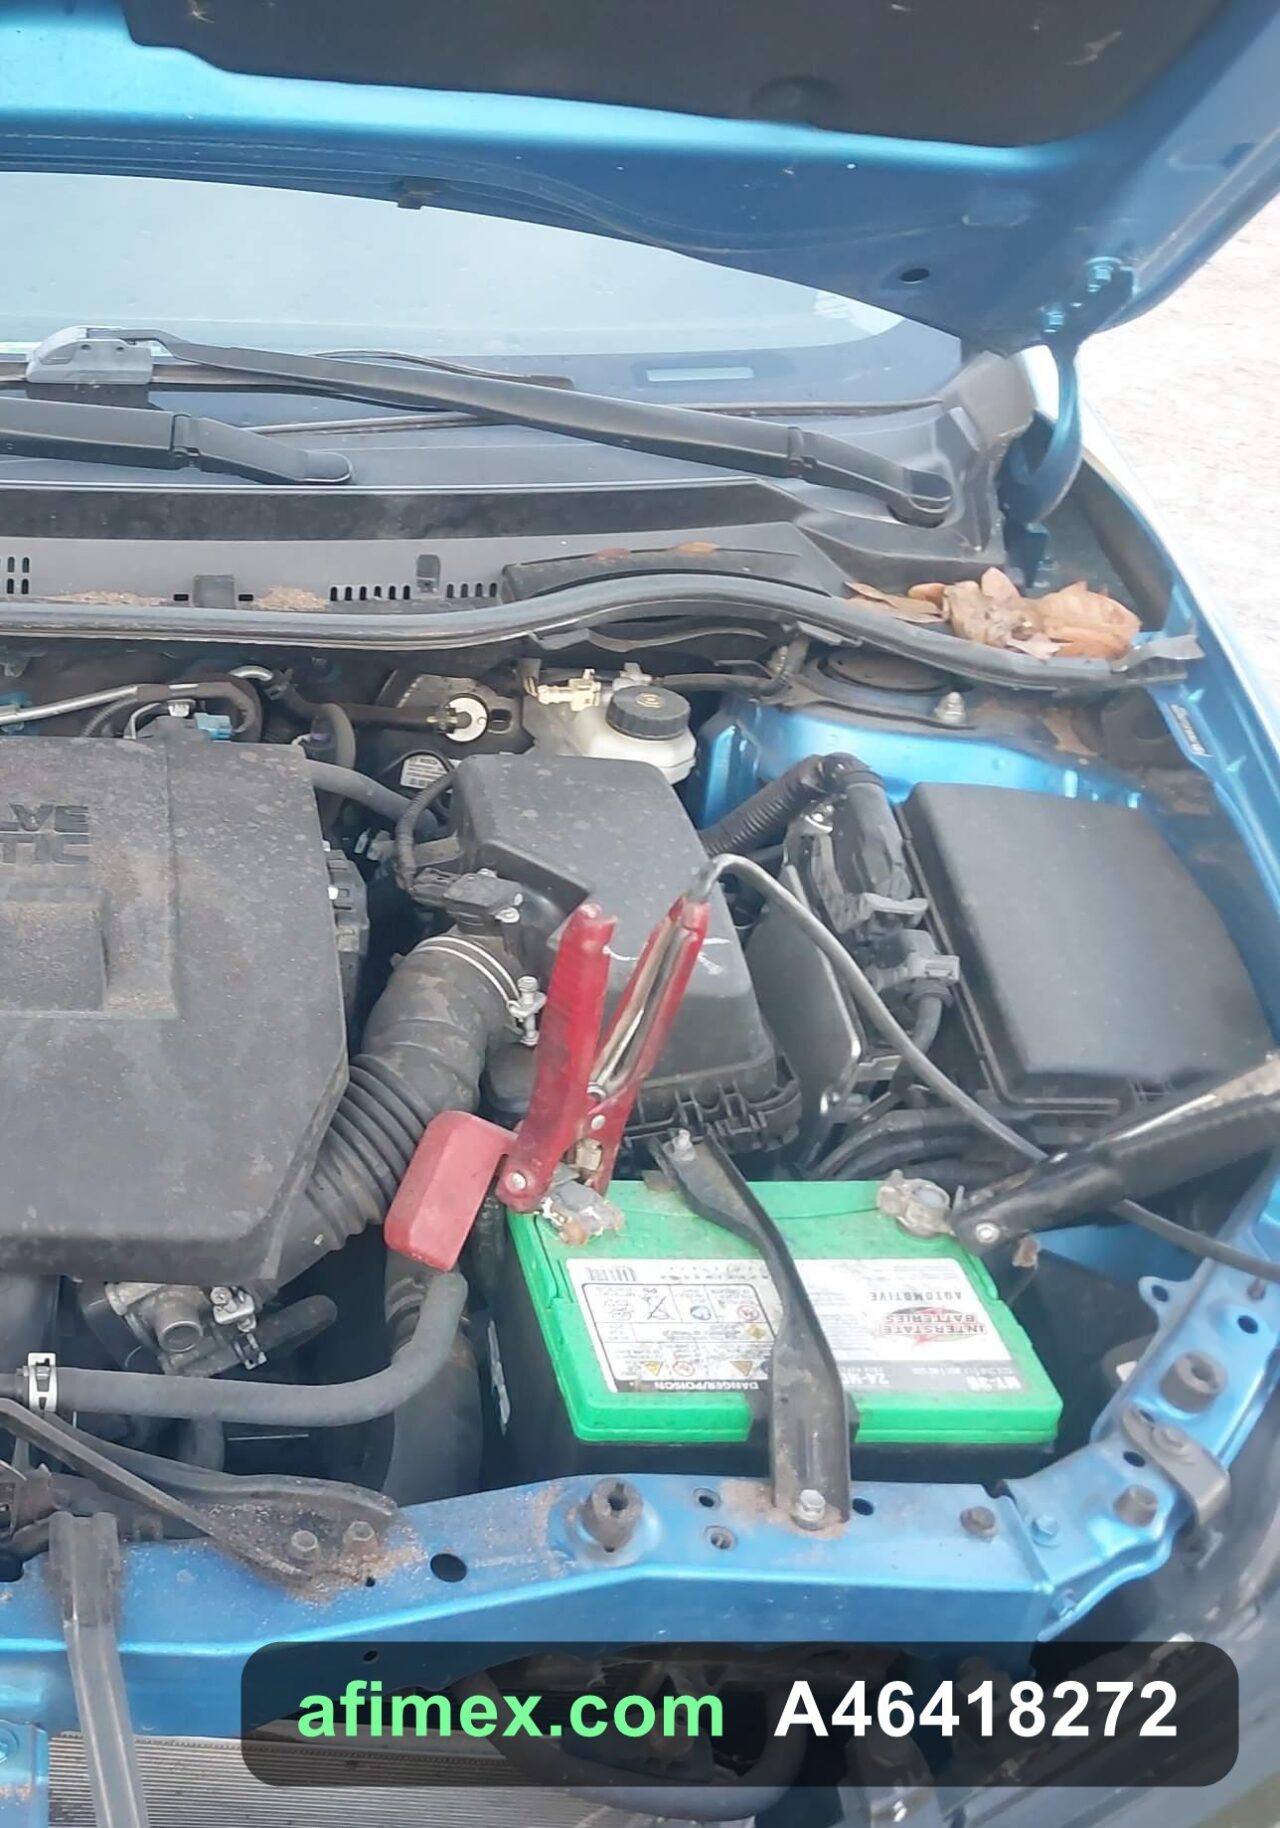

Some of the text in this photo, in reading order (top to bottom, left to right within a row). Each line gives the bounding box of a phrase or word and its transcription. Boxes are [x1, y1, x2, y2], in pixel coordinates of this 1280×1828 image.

[871, 1290, 962, 1302] AUTOMOTIVE
[884, 1313, 976, 1323] BATTERIES
[881, 1324, 985, 1334] INTERSTATE
[653, 1381, 760, 1391] DANGER/POISON
